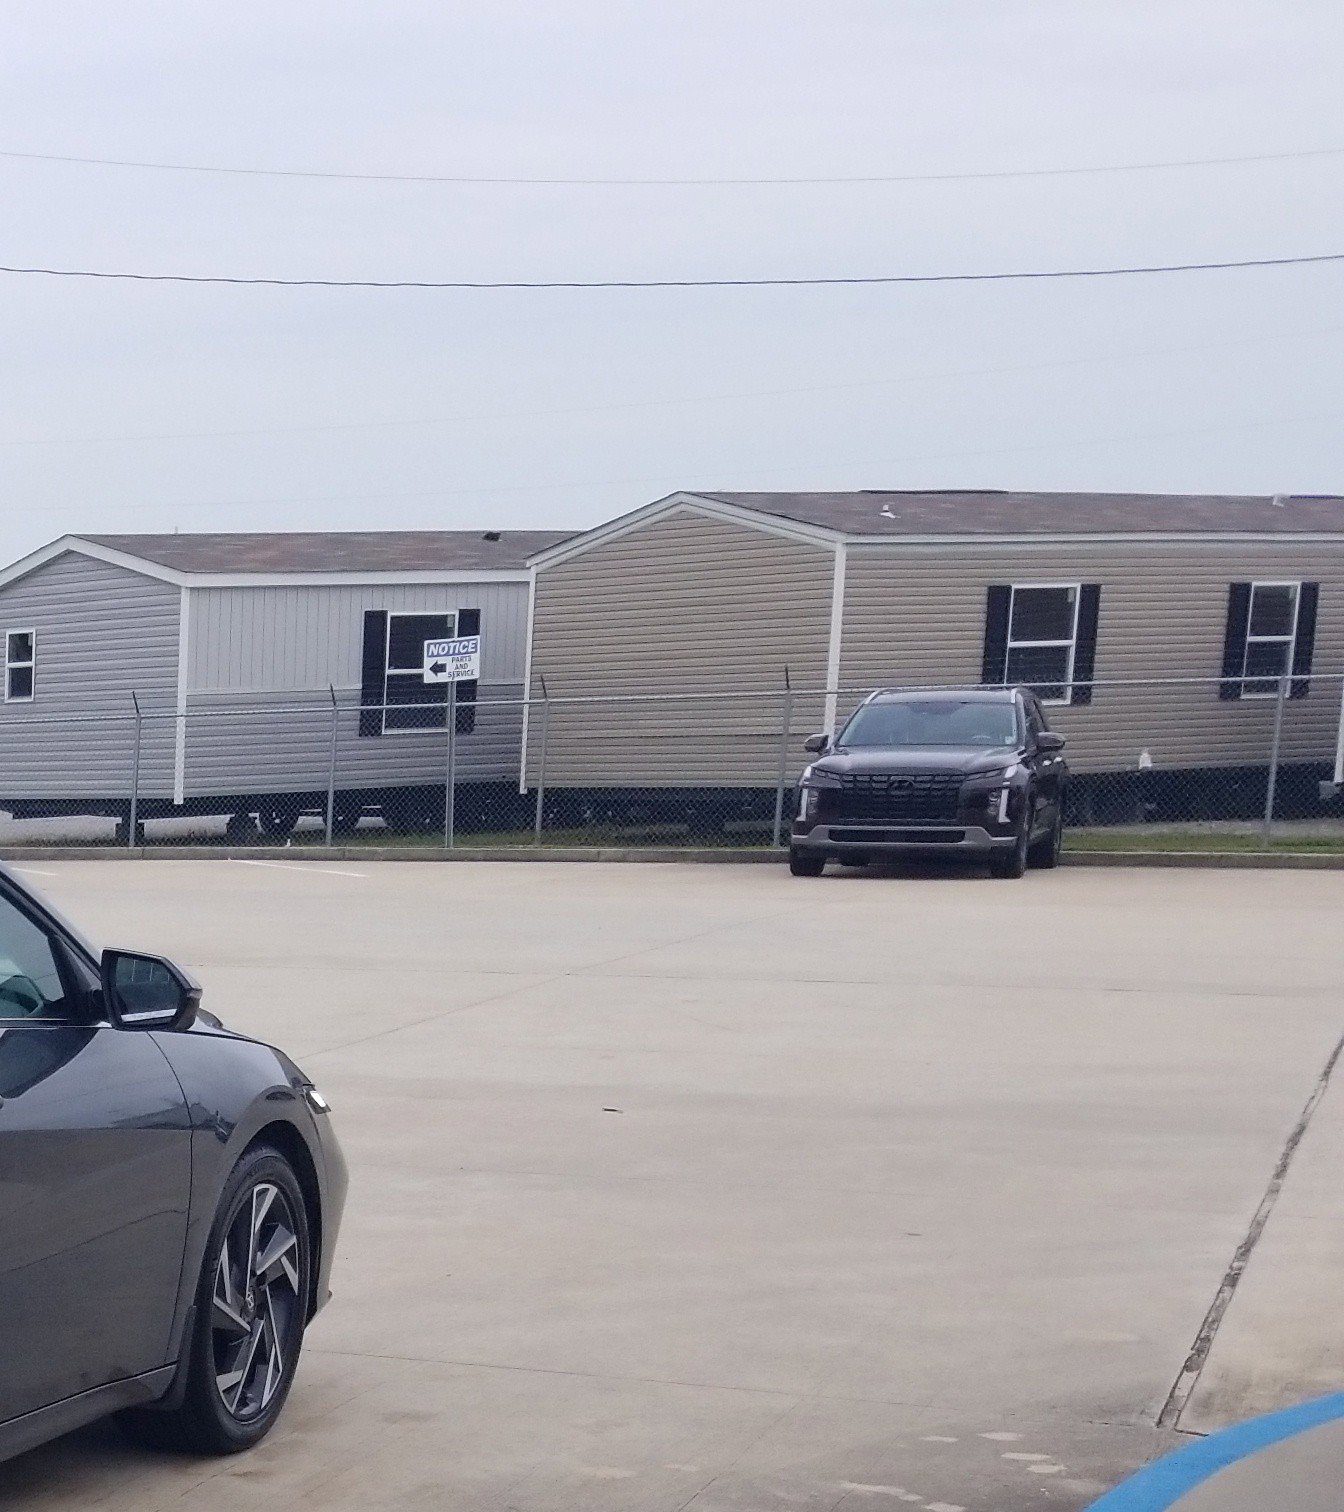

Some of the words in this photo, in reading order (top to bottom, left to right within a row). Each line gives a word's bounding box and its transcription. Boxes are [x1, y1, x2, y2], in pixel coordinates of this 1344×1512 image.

[428, 640, 477, 655] NOTICE
[454, 662, 469, 671] AND
[447, 669, 475, 678] SERVICE
